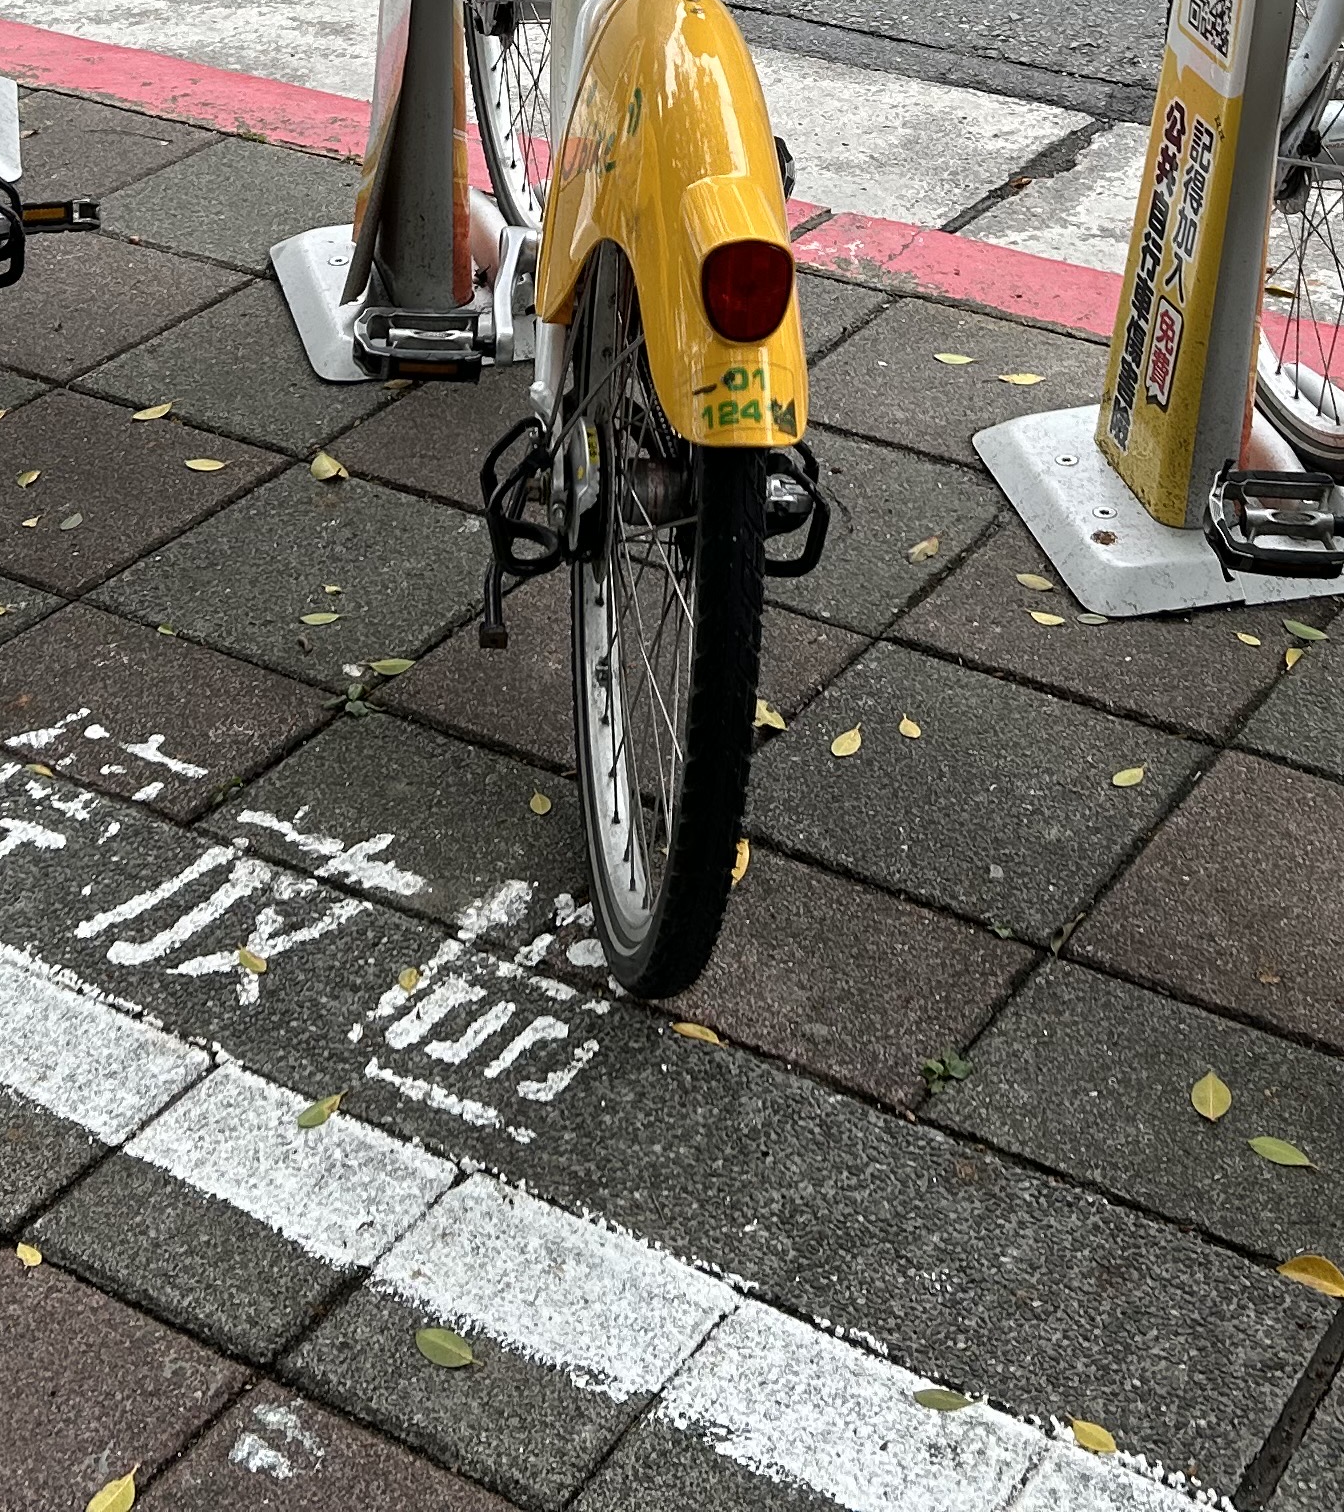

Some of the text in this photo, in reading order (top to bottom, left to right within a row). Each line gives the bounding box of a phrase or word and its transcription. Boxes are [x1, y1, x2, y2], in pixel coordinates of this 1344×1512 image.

[1164, 117, 1215, 304] 記得加入
[723, 366, 767, 392] 01
[1150, 308, 1179, 396] 免費
